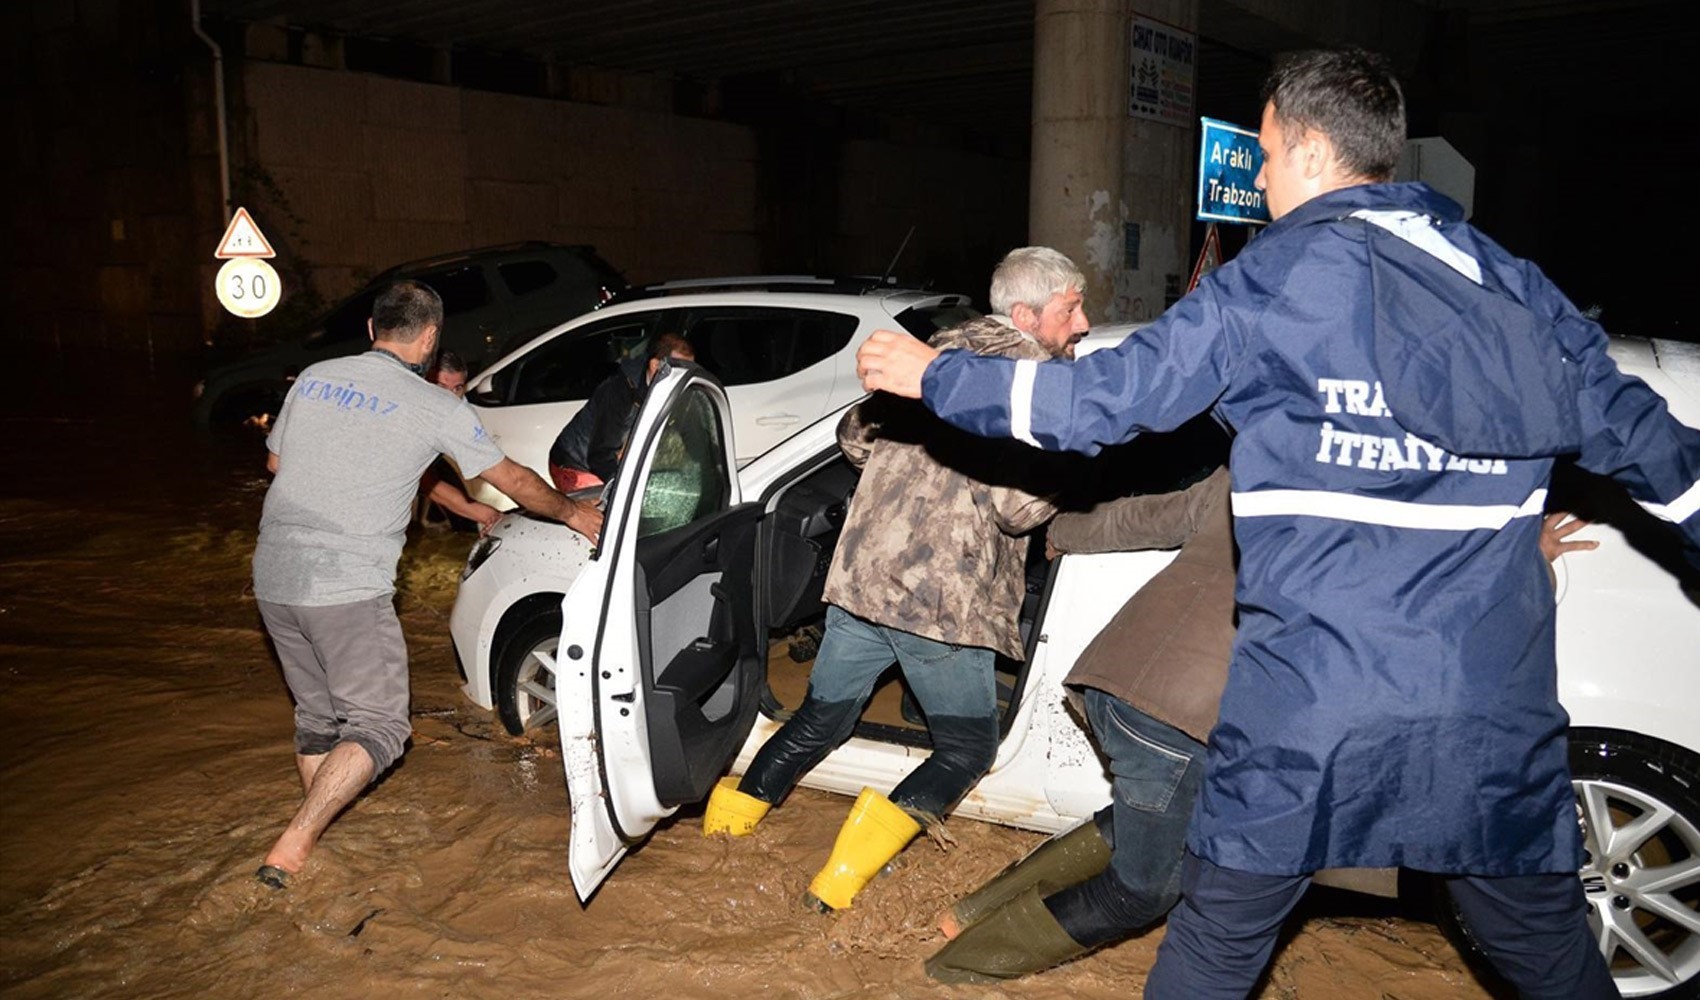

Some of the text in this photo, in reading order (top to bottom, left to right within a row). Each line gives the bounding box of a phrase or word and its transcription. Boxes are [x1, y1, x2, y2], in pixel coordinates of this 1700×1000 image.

[1210, 141, 1253, 171] Araklı
[1209, 178, 1261, 208] Trabzon
[231, 274, 266, 299] 30
